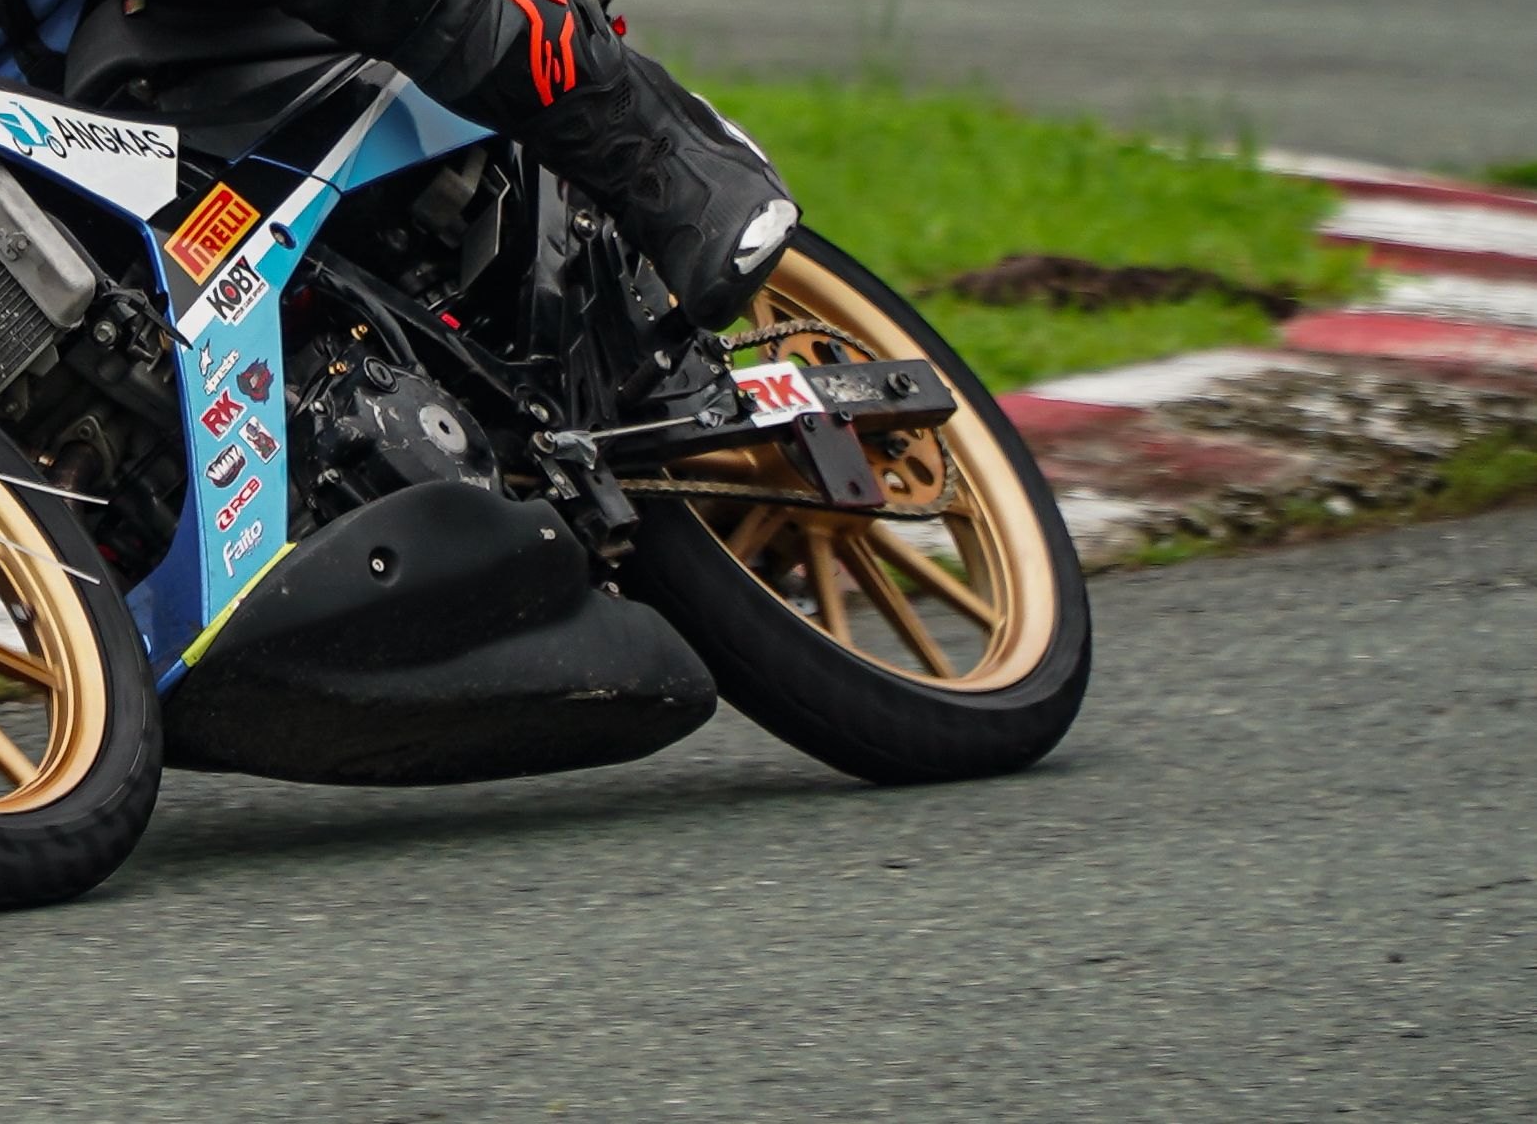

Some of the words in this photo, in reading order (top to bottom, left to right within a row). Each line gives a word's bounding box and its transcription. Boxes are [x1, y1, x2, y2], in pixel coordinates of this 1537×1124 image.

[52, 115, 176, 160] ANGKAS
[171, 189, 253, 277] PIRELLI
[206, 255, 261, 321] KOBY
[201, 390, 245, 439] RK
[736, 373, 811, 412] RK
[230, 477, 260, 514] RCB
